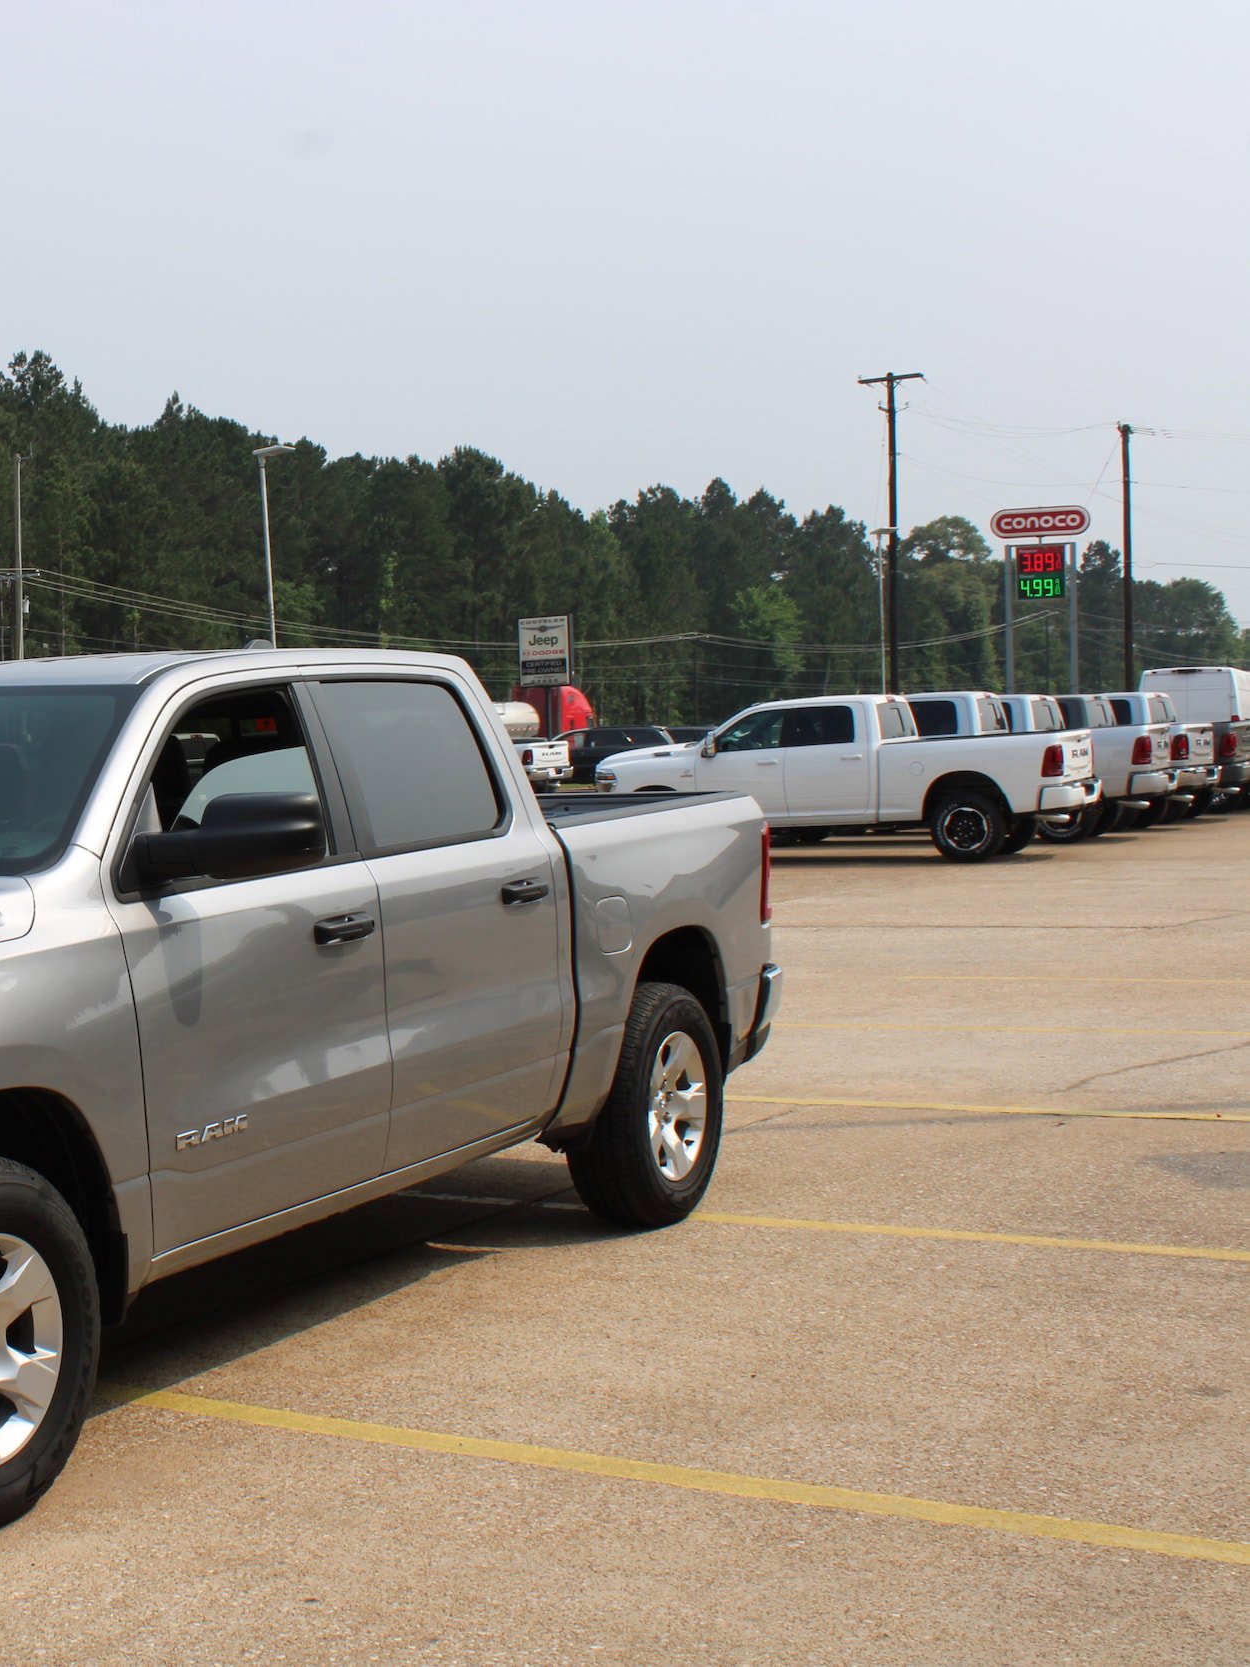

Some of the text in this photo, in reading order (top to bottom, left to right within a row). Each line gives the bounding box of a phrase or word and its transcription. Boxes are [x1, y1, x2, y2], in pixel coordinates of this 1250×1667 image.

[528, 634, 559, 647] Jeep
[522, 666, 566, 674] PRE-OWNED
[1072, 749, 1089, 759] RAM
[176, 1114, 248, 1150] RAM
